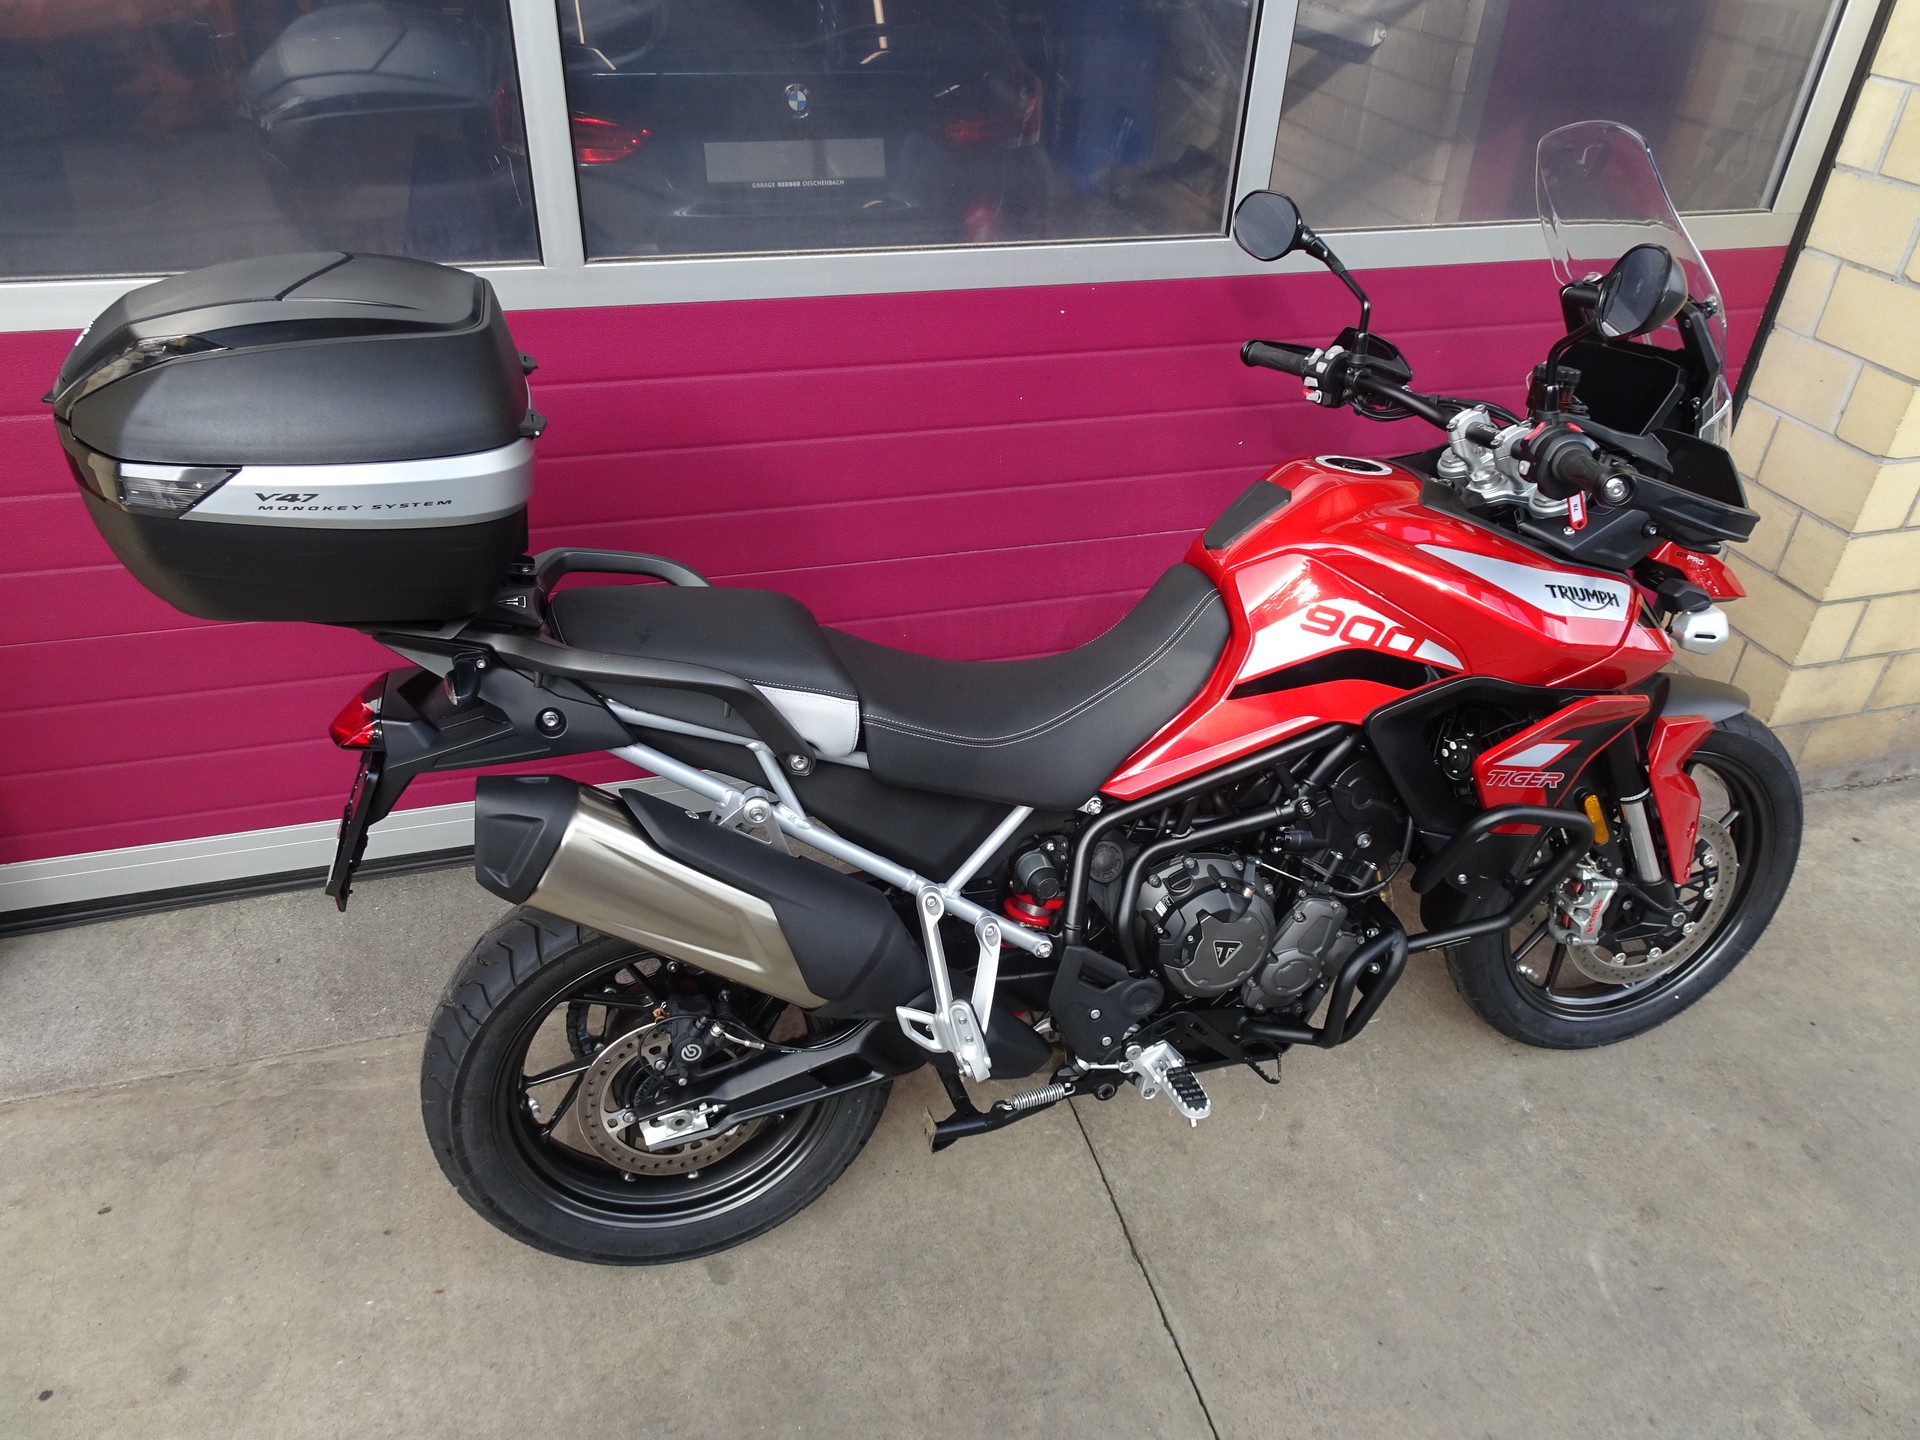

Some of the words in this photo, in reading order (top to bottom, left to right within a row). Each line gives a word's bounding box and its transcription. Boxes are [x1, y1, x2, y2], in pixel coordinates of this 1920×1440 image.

[255, 492, 320, 503] V47
[371, 500, 453, 510] SYSTEM
[1544, 584, 1620, 610] TRIUMPH
[1299, 604, 1424, 658] 900
[1486, 769, 1565, 789] TIGER
[1585, 899, 1604, 934] brembo
